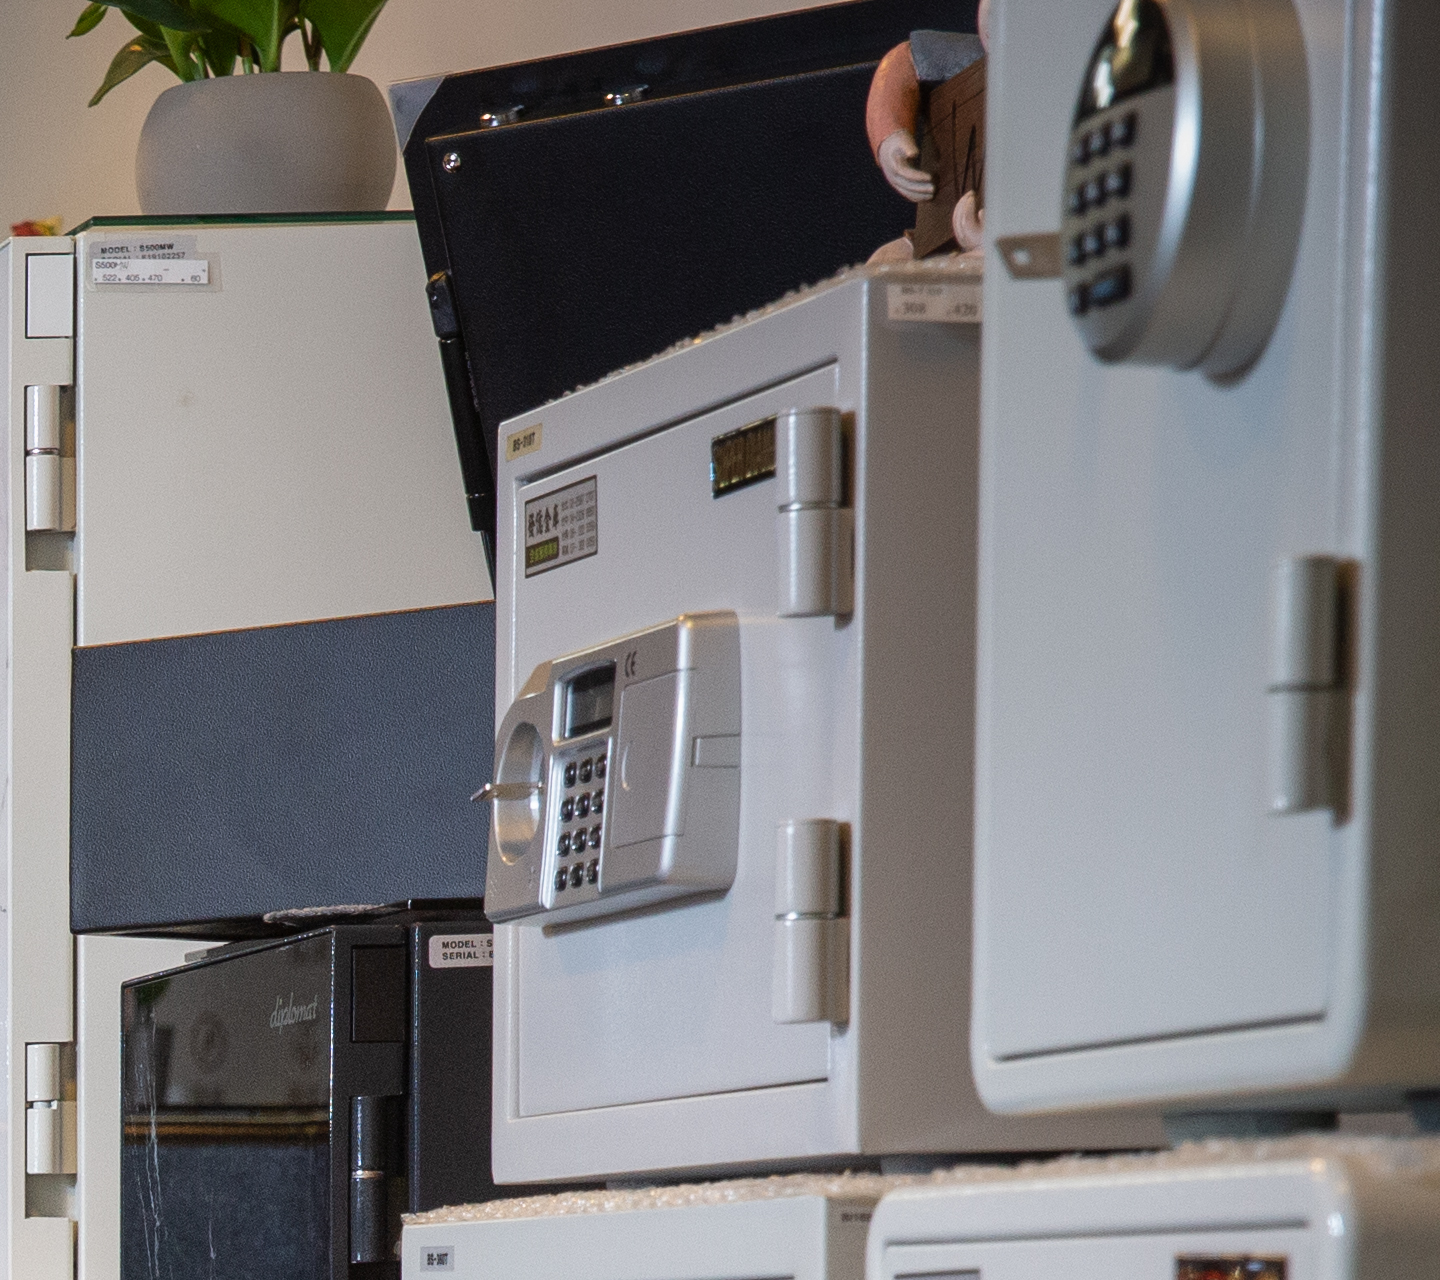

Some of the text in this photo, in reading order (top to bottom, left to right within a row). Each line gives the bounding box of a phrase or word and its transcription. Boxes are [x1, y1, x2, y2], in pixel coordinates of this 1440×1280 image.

[101, 246, 130, 254] MODEL
[441, 939, 477, 949] MODEL
[441, 950, 479, 960] SERIAL
[269, 991, 319, 1034] diplomat
